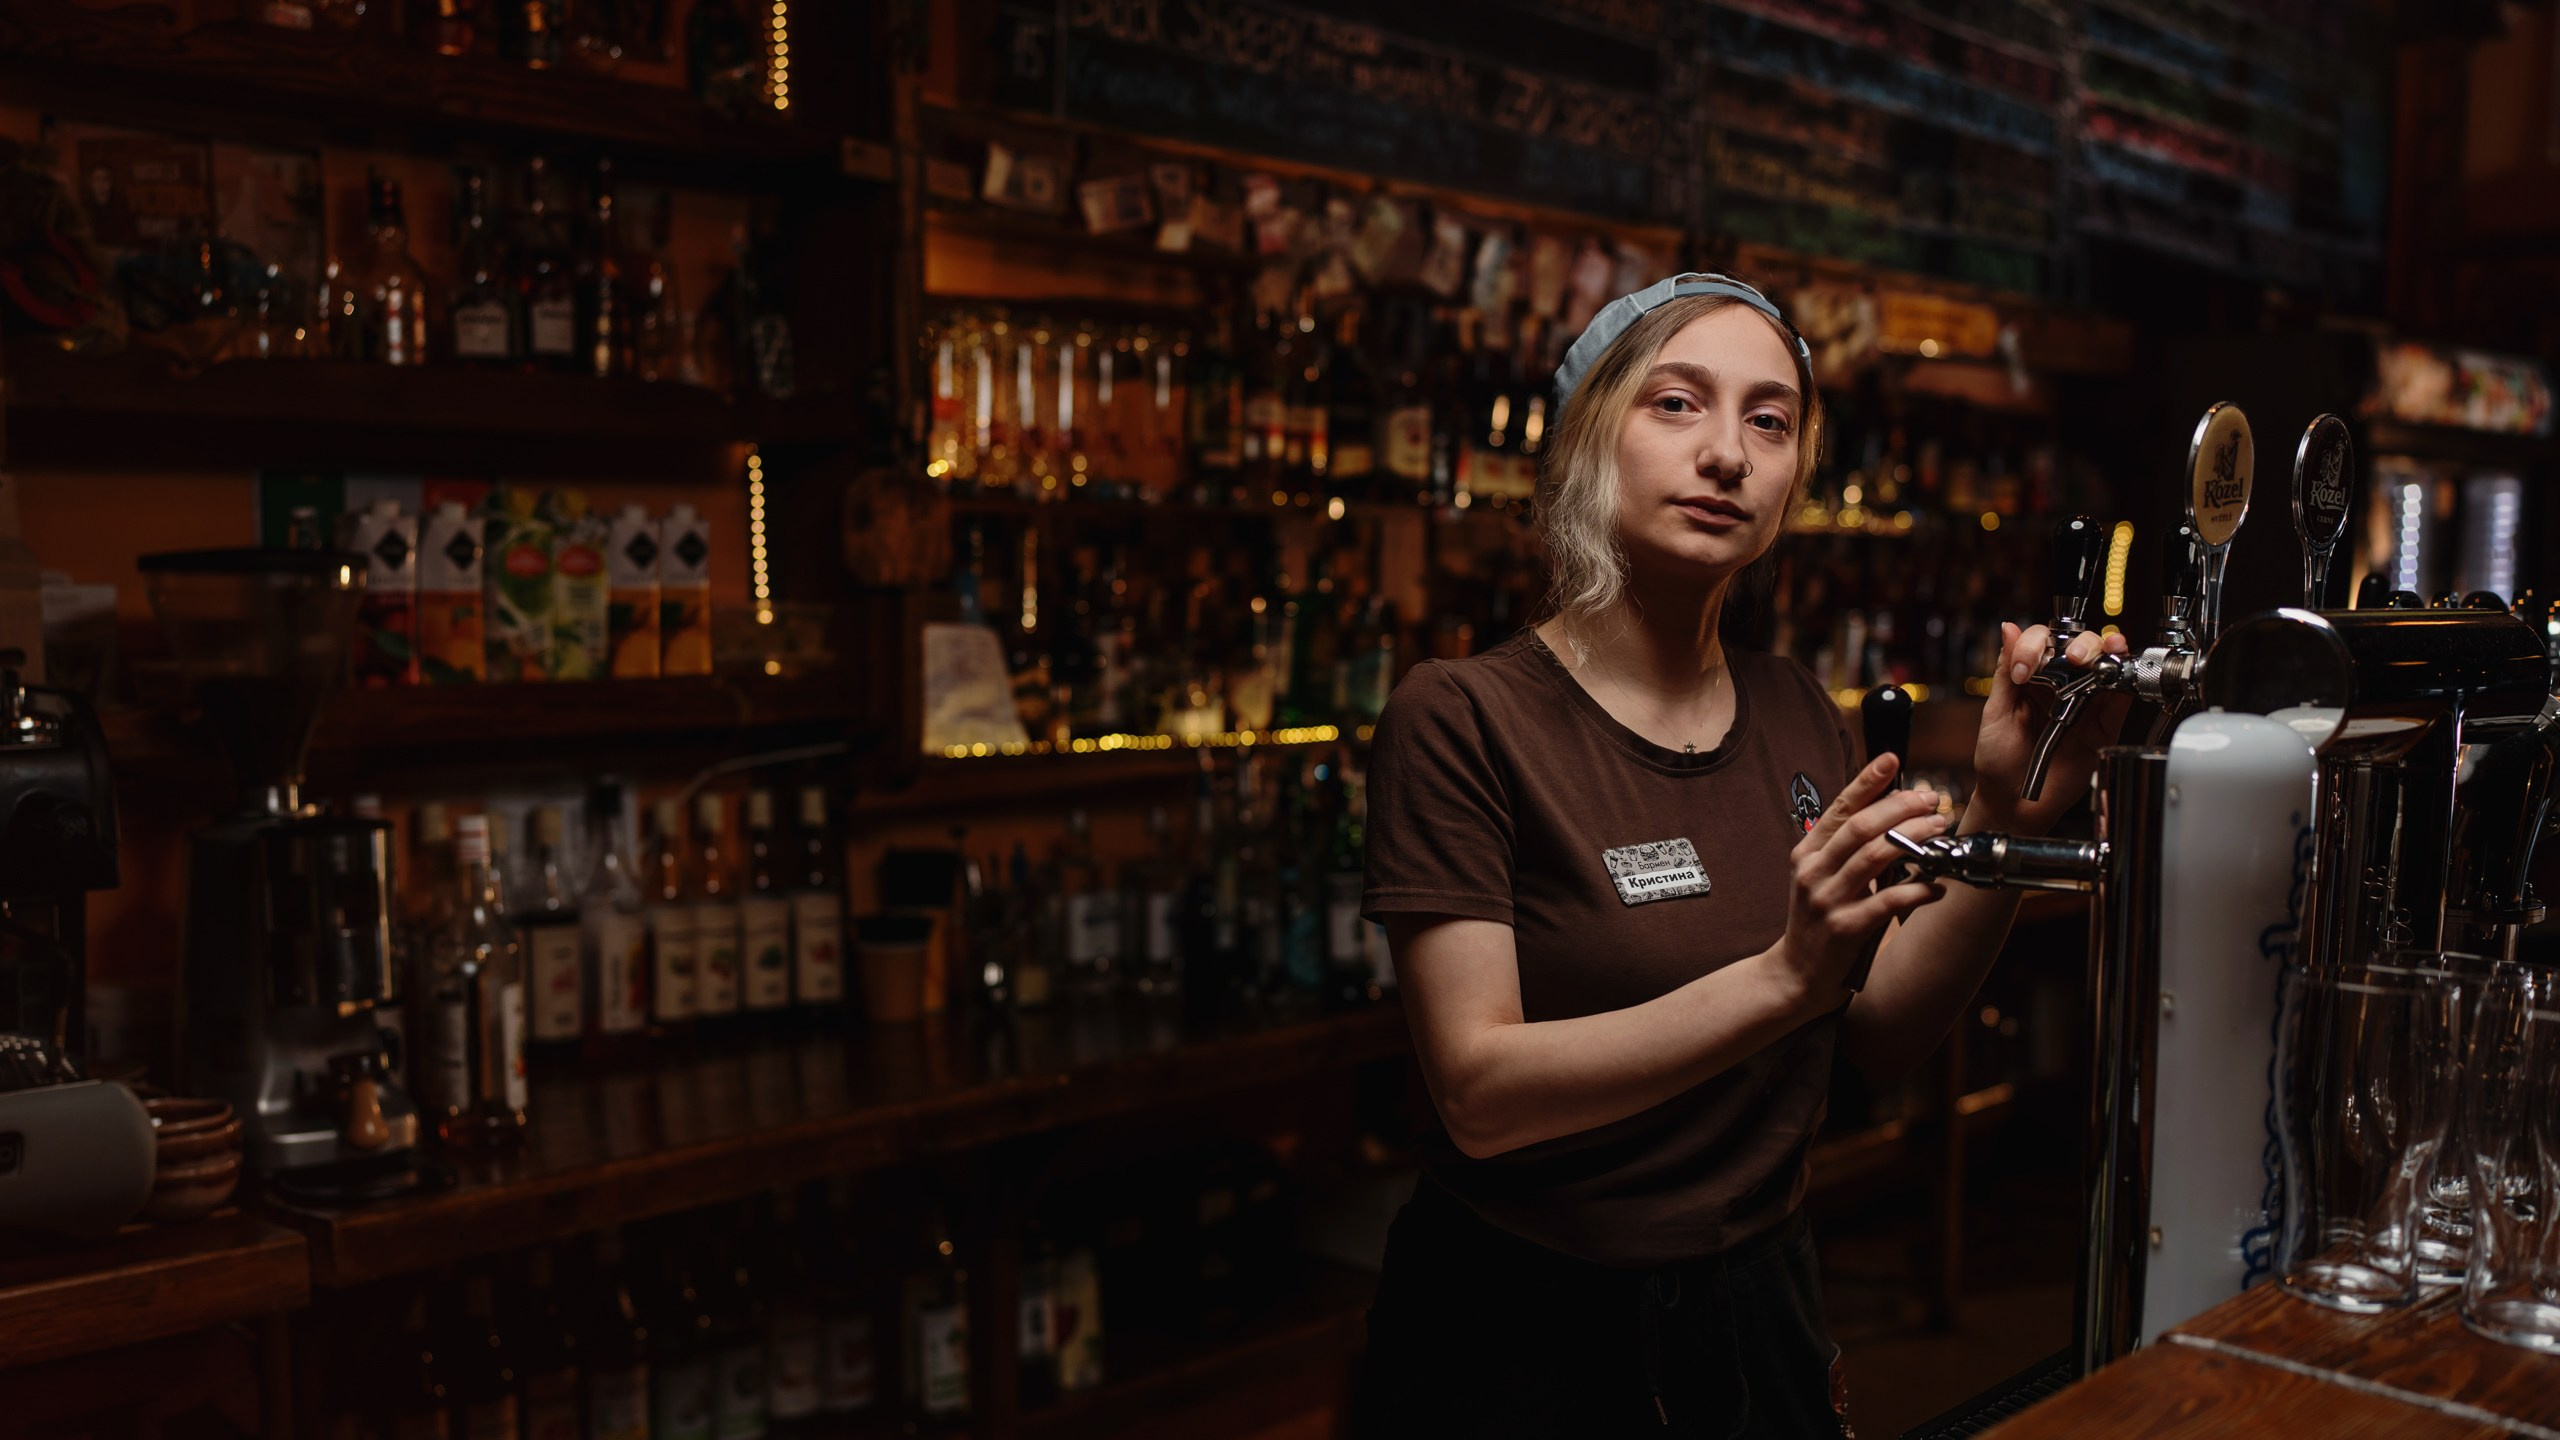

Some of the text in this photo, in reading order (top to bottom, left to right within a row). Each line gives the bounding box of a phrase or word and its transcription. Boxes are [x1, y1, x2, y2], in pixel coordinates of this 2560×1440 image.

[2203, 478, 2244, 508] Kozel
[2309, 480, 2346, 510] Kozel
[1638, 860, 1671, 871] Бармен
[1628, 870, 1695, 889] Кристина
